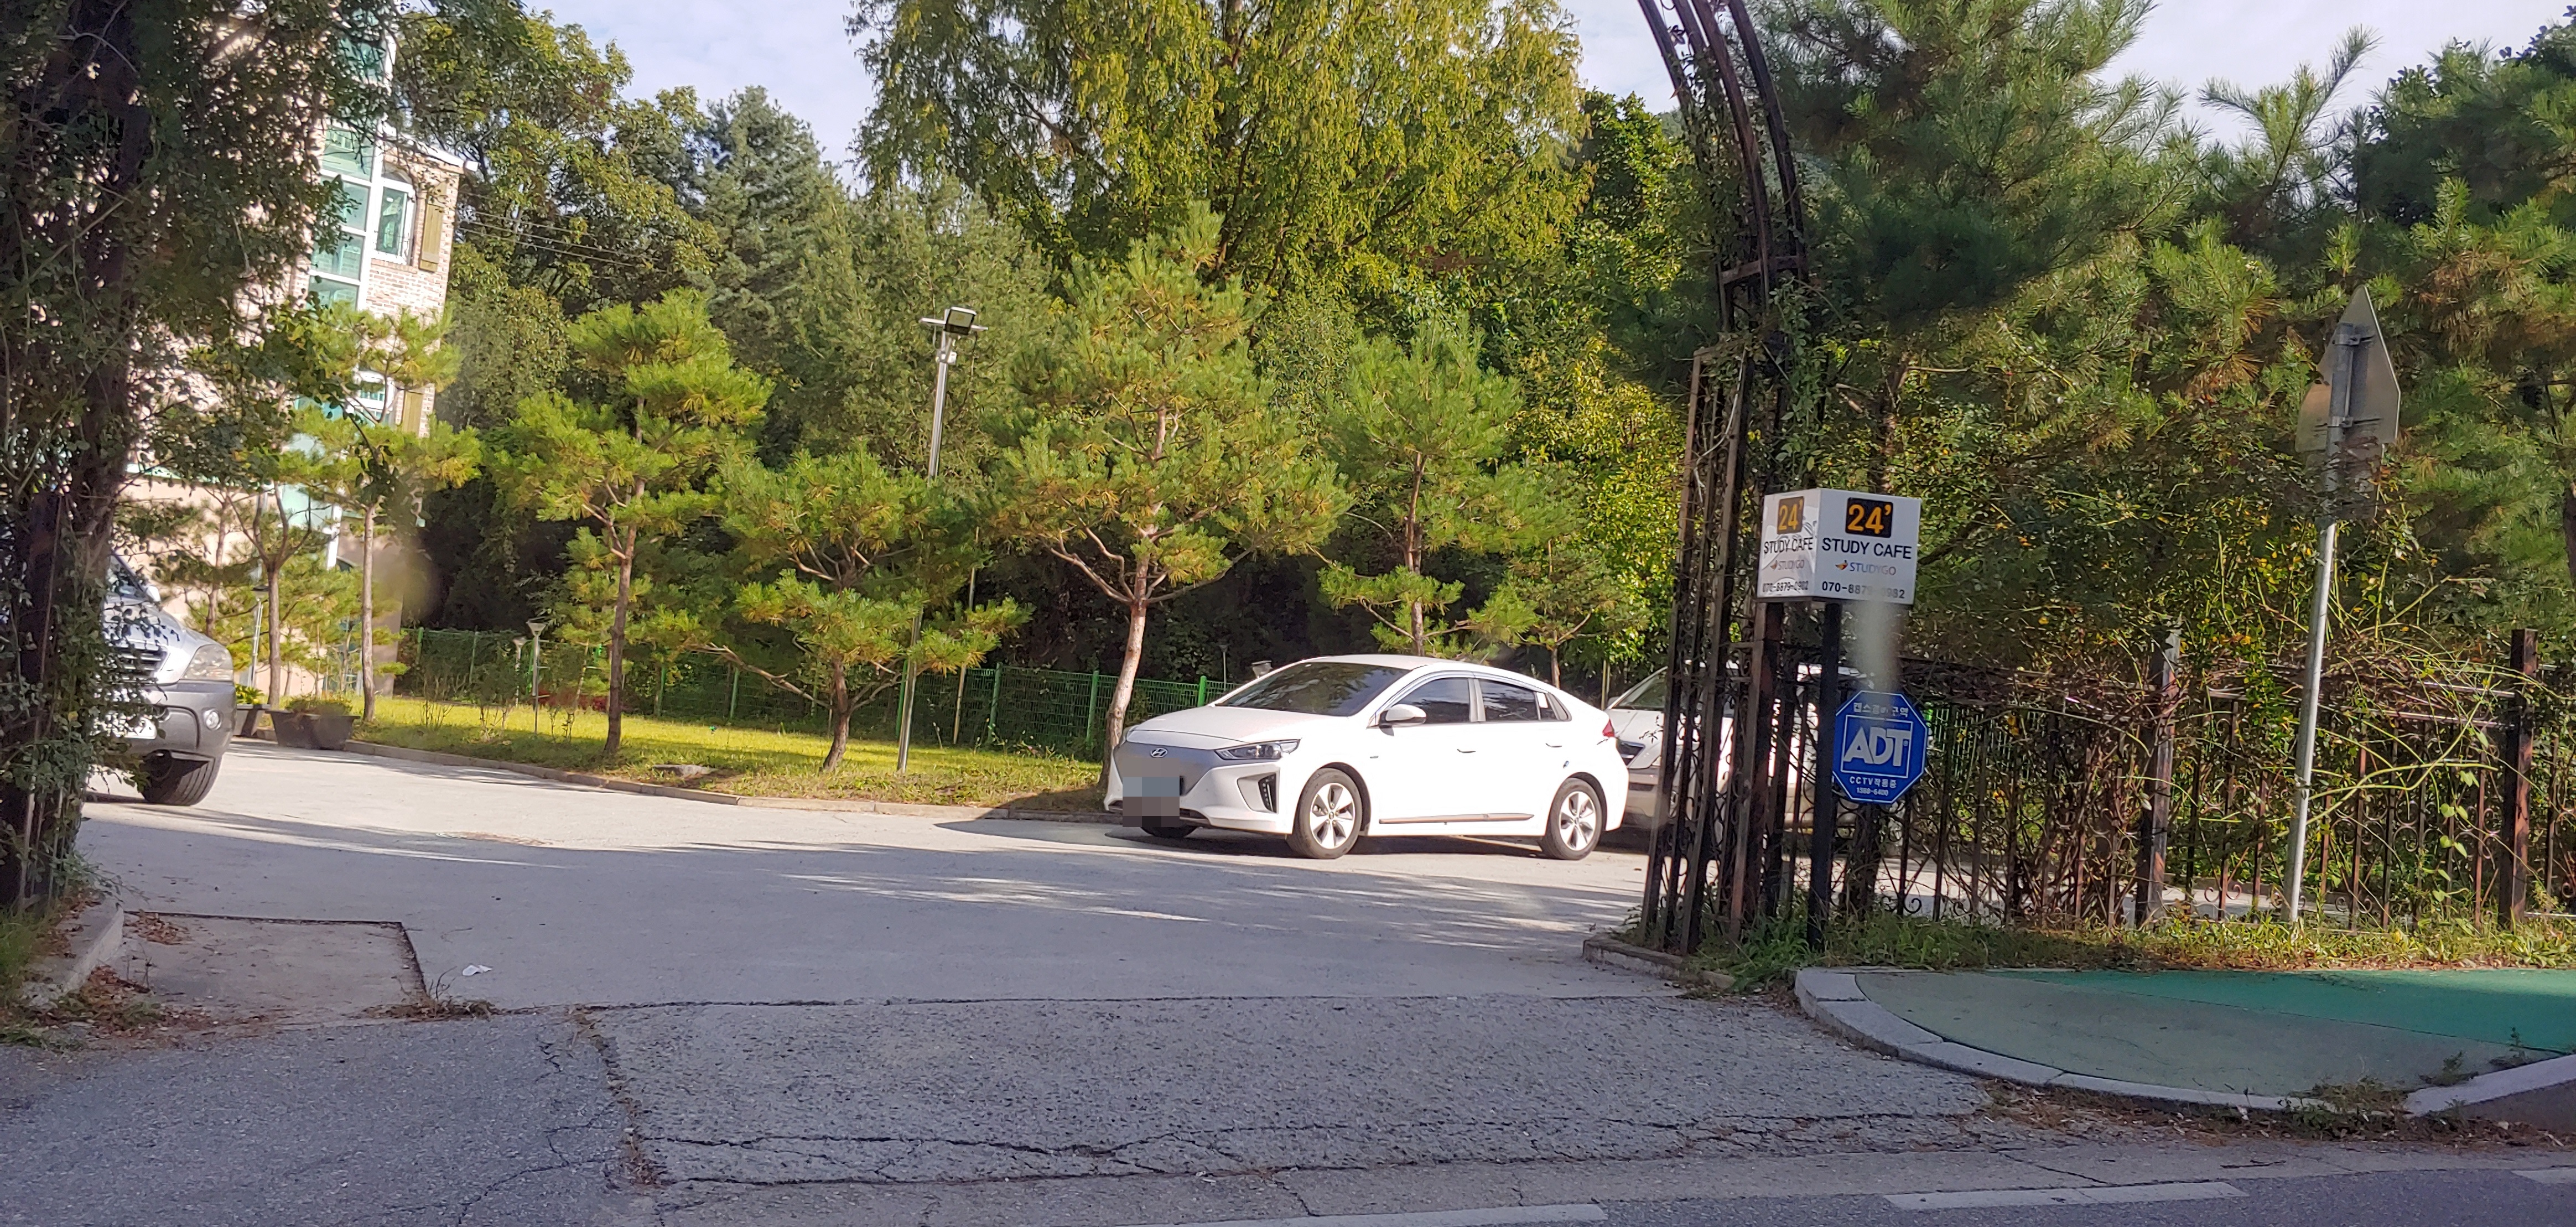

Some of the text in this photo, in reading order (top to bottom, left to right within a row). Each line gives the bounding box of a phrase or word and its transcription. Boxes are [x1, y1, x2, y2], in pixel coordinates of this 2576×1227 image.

[1847, 504, 1892, 535] 24'
[1763, 537, 1814, 554] STUDY CAFE
[1821, 538, 1912, 559] STUDY CAFE
[1850, 561, 1897, 576] STUDYGO
[1842, 726, 1912, 767] ADT
